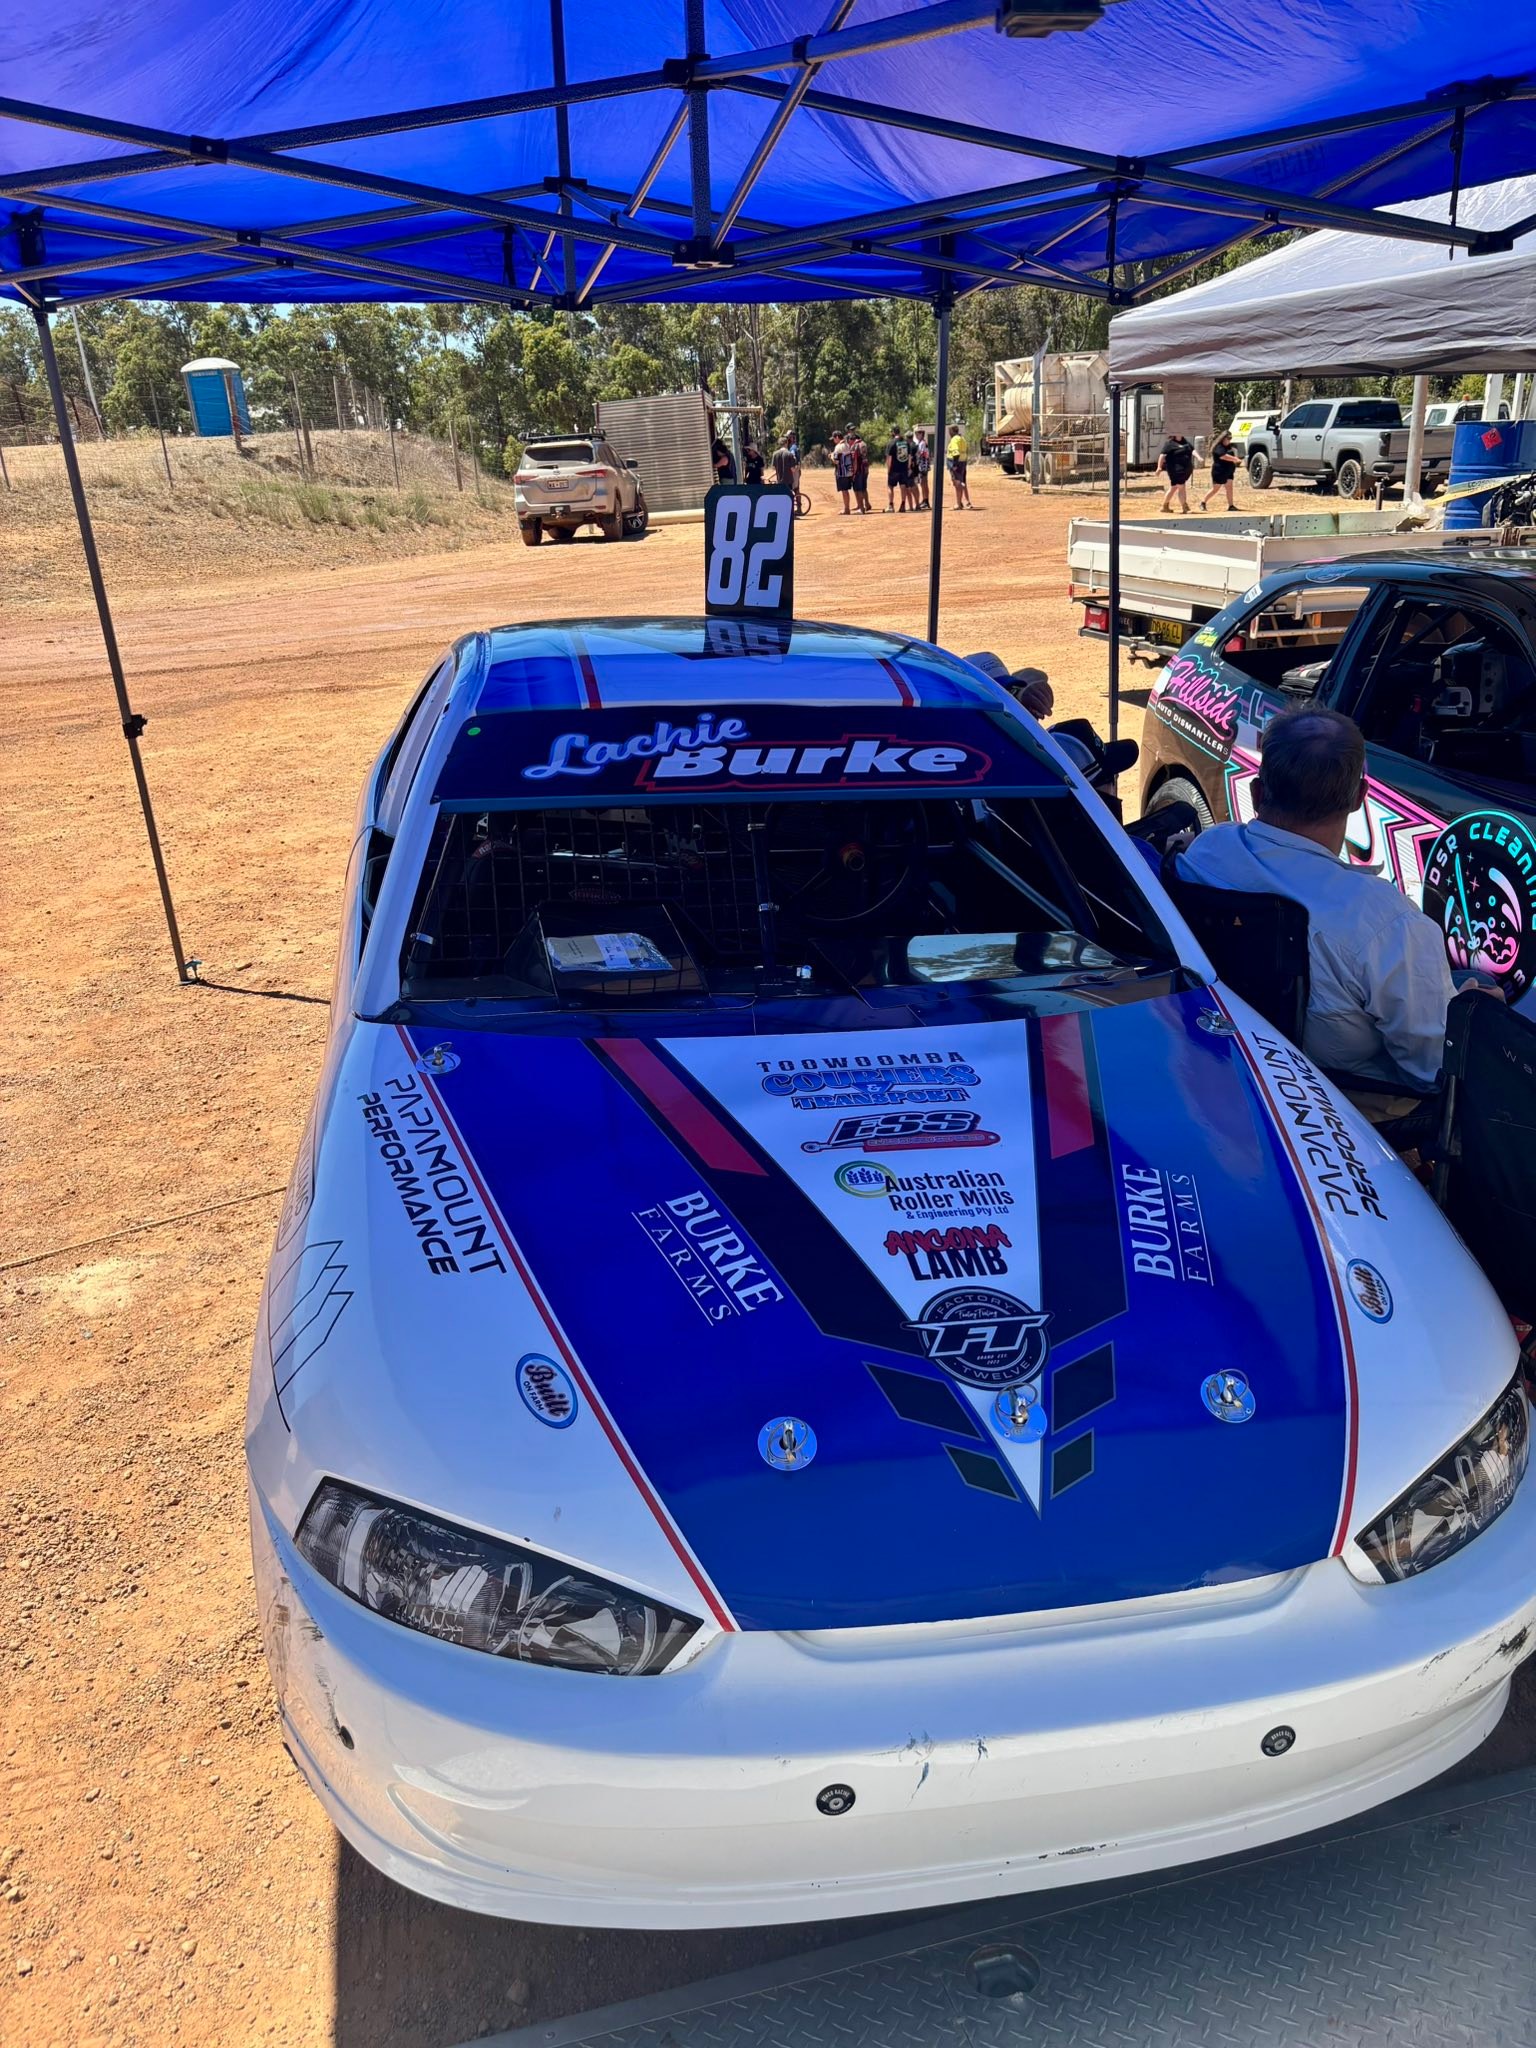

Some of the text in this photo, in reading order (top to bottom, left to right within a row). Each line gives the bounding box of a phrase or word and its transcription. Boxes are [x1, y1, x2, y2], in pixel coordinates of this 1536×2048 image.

[707, 494, 792, 608] 82
[1167, 661, 1239, 731] Hillside
[522, 713, 748, 779] Lachie
[1157, 703, 1229, 756] AUTO DISMANTLERS
[654, 739, 968, 778] Burke
[1429, 834, 1458, 886] DSR
[756, 1051, 966, 1073] TOOWOOMBA
[761, 1064, 981, 1096] COURIERS
[791, 1087, 971, 1110] TRANSPORT
[832, 1111, 981, 1144] ESS
[1285, 1049, 1389, 1220] PERFORMANCE
[357, 1092, 460, 1275] PERFORMANCE
[885, 1169, 1006, 1193] Australian
[888, 1188, 1015, 1212] Roller Mills
[906, 1206, 1010, 1220] & Engineering Pty Ltd
[1122, 1164, 1176, 1279] BURKE
[1175, 1173, 1208, 1283] FARMS
[637, 1208, 733, 1322] FARMS
[666, 1190, 784, 1312] BURKE
[906, 1246, 1009, 1281] LAMB
[937, 1295, 1013, 1315] FACTORY
[1353, 1266, 1384, 1315] Built
[524, 1364, 571, 1417] Built
[962, 1362, 1031, 1380] TWELVE
